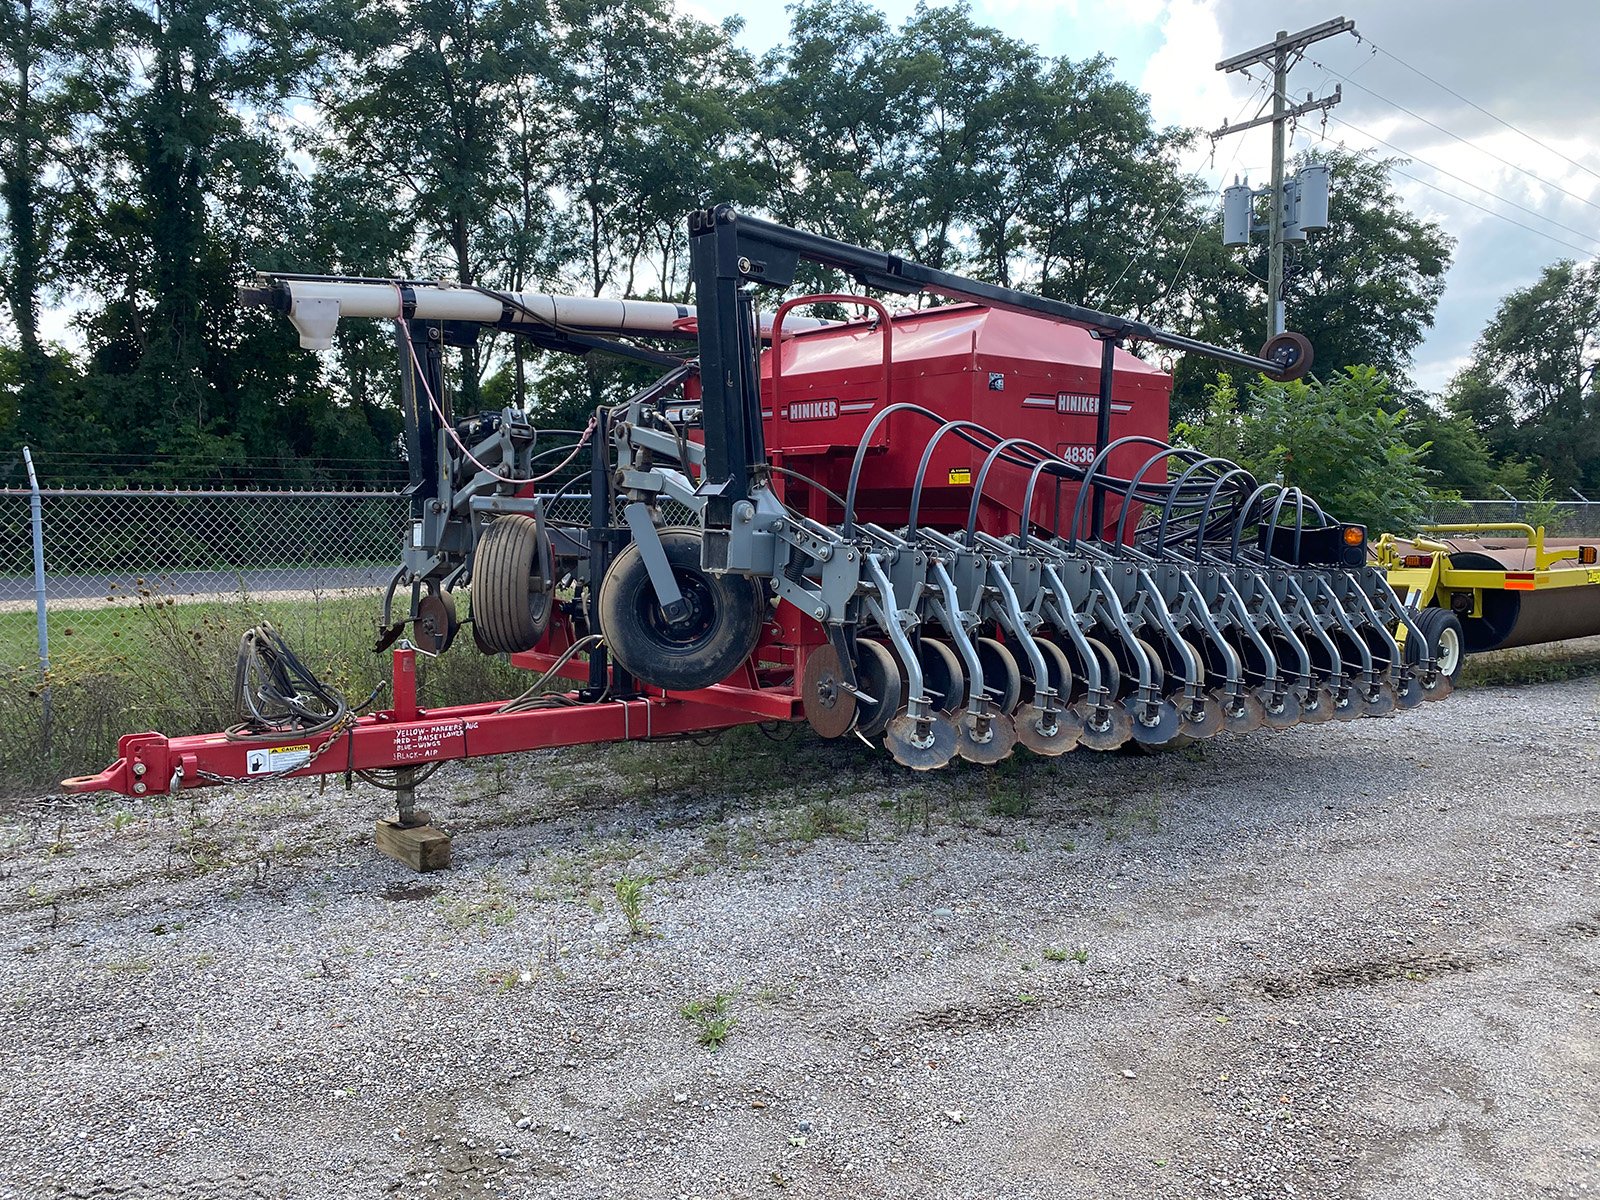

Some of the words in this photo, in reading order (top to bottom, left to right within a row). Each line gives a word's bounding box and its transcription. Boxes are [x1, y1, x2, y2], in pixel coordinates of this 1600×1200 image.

[790, 401, 837, 419] HINIKER
[1064, 446, 1095, 463] 4836
[281, 745, 309, 753] CAUTION
